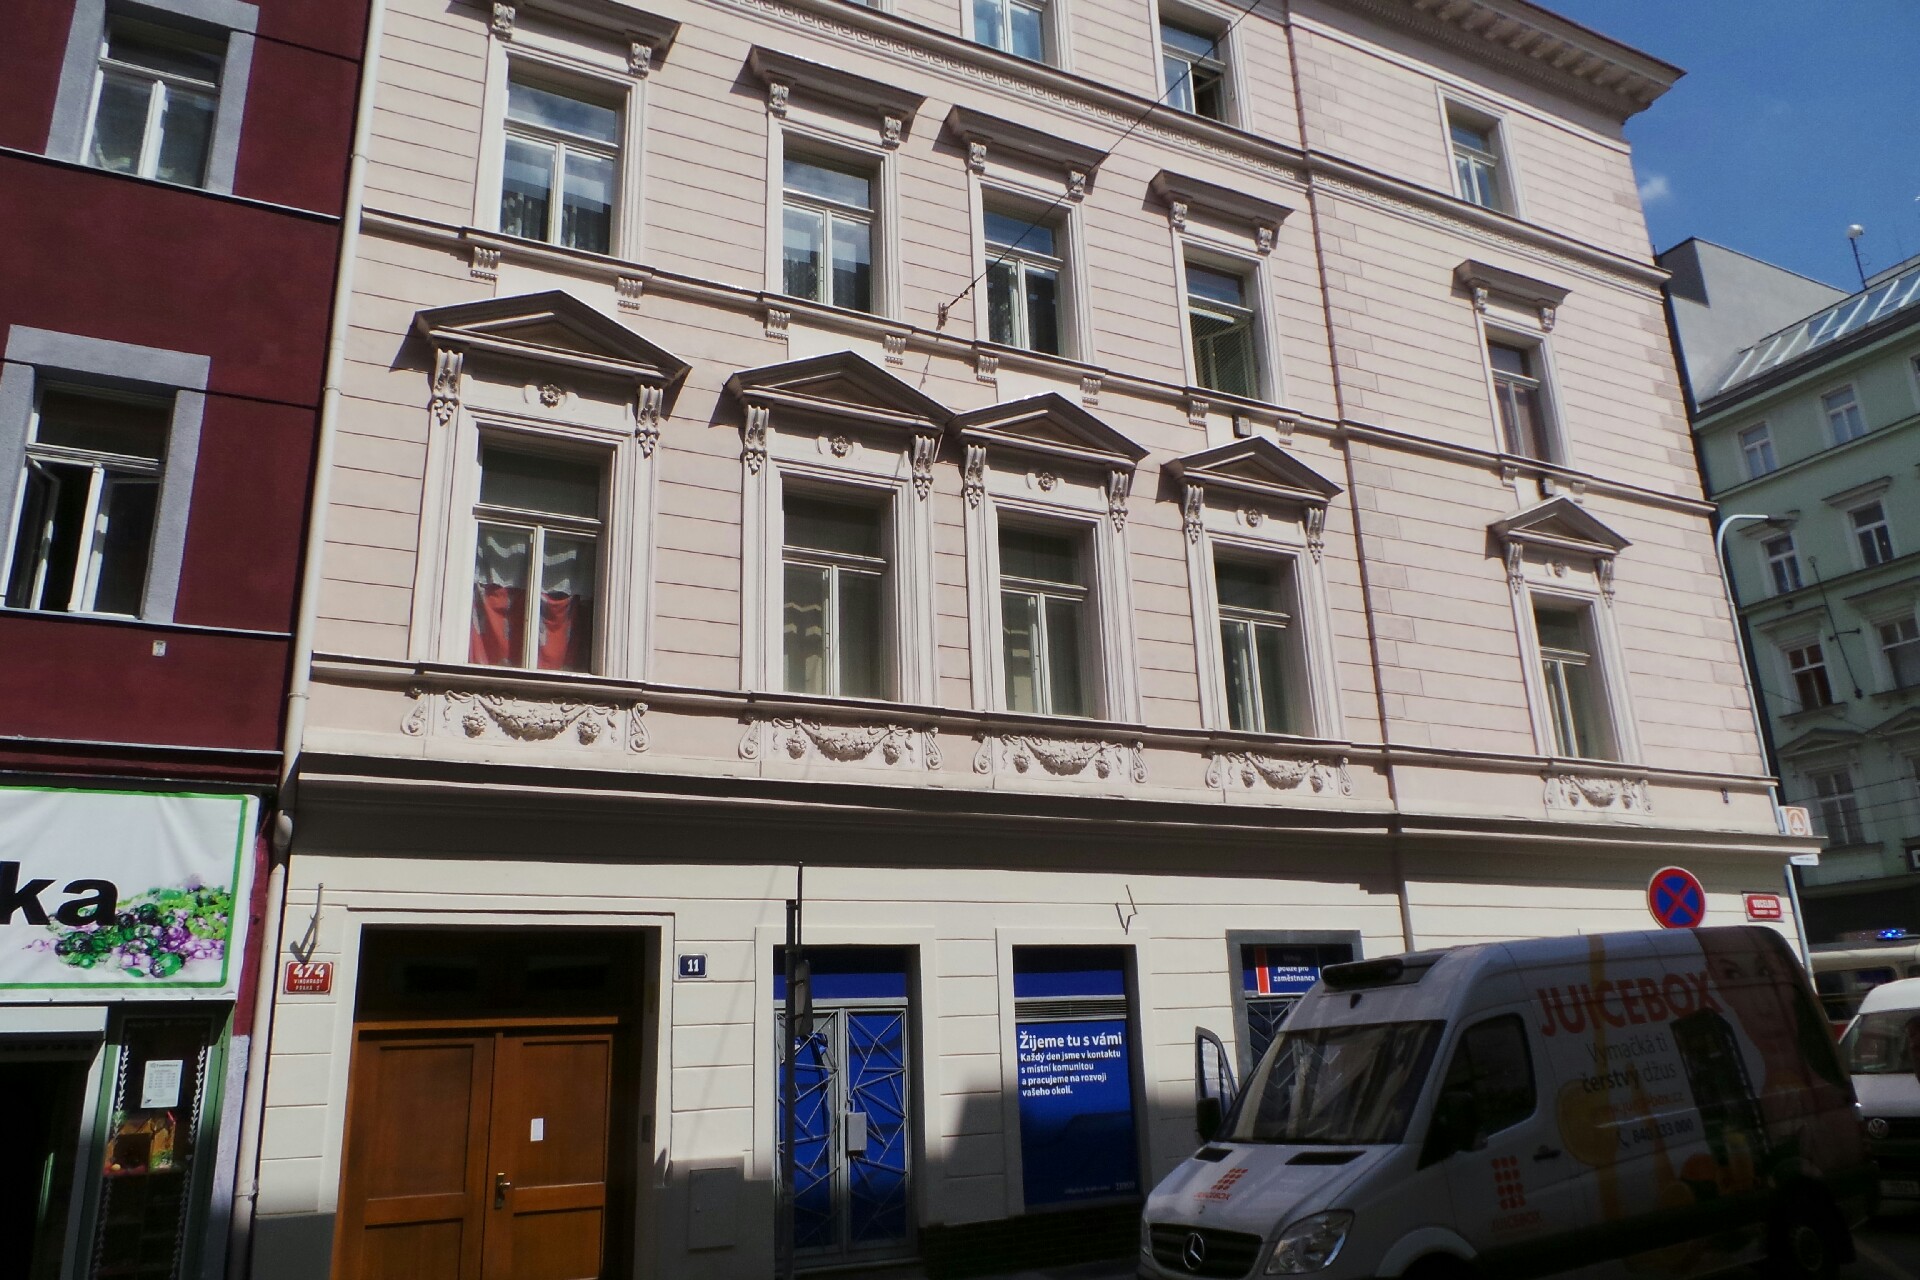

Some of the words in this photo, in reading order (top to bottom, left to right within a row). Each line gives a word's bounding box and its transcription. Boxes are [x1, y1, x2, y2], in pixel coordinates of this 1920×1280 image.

[0, 860, 118, 927] ka
[293, 963, 325, 978] 474
[687, 958, 699, 972] 11
[1277, 966, 1298, 974] pouze
[1298, 966, 1309, 974] pro
[1273, 974, 1316, 982] zaměstnance
[1537, 971, 1724, 1037] JUICEBOX
[1019, 1030, 1065, 1051] Žijeme
[1066, 1034, 1081, 1047] tu
[1083, 1035, 1090, 1046] s
[1092, 1031, 1123, 1046] vámi
[1020, 1052, 1045, 1063] Každý
[1046, 1052, 1060, 1061] den
[1060, 1051, 1082, 1062] jsme
[1086, 1049, 1121, 1059] kontaktu
[1585, 1034, 1656, 1064] Vymačká
[1655, 1033, 1669, 1052] ti
[1021, 1066, 1026, 1074] s
[1026, 1063, 1051, 1074] místní
[1052, 1062, 1094, 1072] komunitou
[1022, 1078, 1027, 1086] a
[1027, 1075, 1069, 1087] pracujeme
[1069, 1075, 1080, 1083] na
[1080, 1072, 1107, 1083] rozvoji
[1582, 1066, 1640, 1093] čerstvý
[1642, 1060, 1677, 1082] džus
[1022, 1087, 1050, 1097] vašeho
[1051, 1085, 1073, 1095] okolí.
